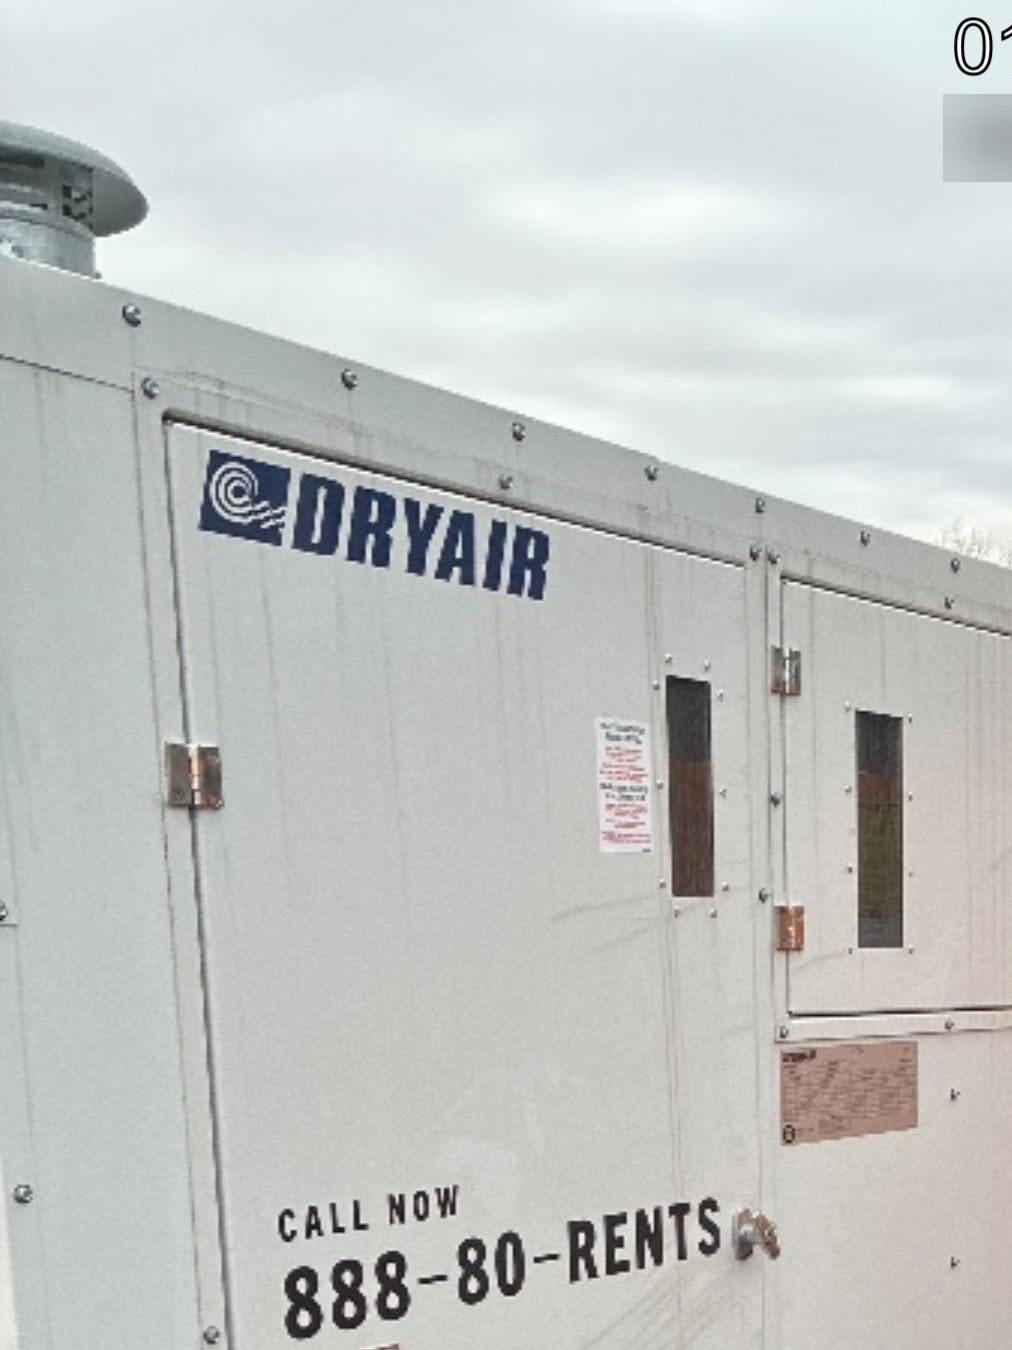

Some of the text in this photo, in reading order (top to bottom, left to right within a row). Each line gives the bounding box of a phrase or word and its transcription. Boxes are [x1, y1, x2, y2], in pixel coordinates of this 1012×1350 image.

[291, 472, 551, 601] DRYAIR
[278, 1184, 460, 1243] CALL NOW
[284, 1196, 721, 1340] 888-80-RENTS
